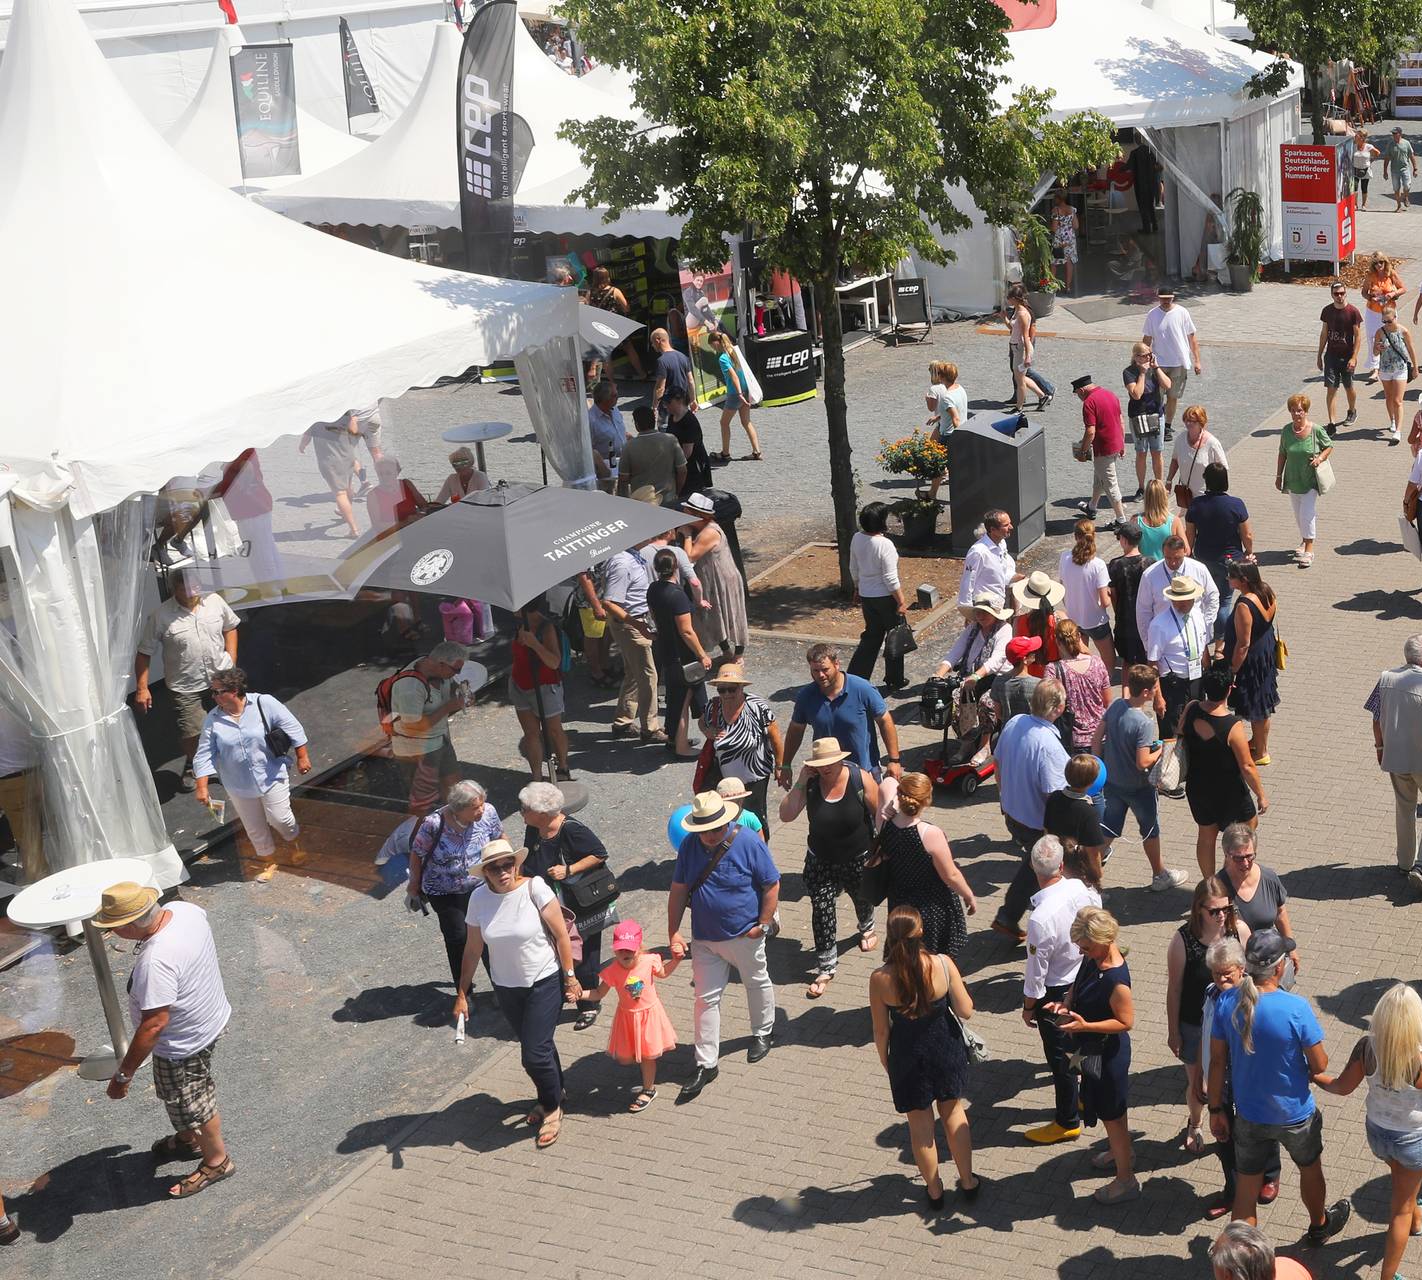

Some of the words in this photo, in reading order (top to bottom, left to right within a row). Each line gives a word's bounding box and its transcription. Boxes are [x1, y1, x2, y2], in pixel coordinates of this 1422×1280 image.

[255, 52, 273, 121] EQUILINE
[465, 73, 501, 157] cep
[501, 82, 510, 138] sportswear
[501, 140, 509, 184] intelligent
[1284, 149, 1324, 157] Sparkassen.
[1284, 157, 1330, 165] Deutschlands
[1285, 165, 1330, 173] Sportförderer
[1285, 172, 1314, 180] Nummer
[513, 236, 526, 246] ep
[904, 285, 919, 294] cep
[782, 349, 809, 368] cep
[544, 519, 629, 562] TAITTINGER
[553, 520, 602, 545] CHAMPAGNE
